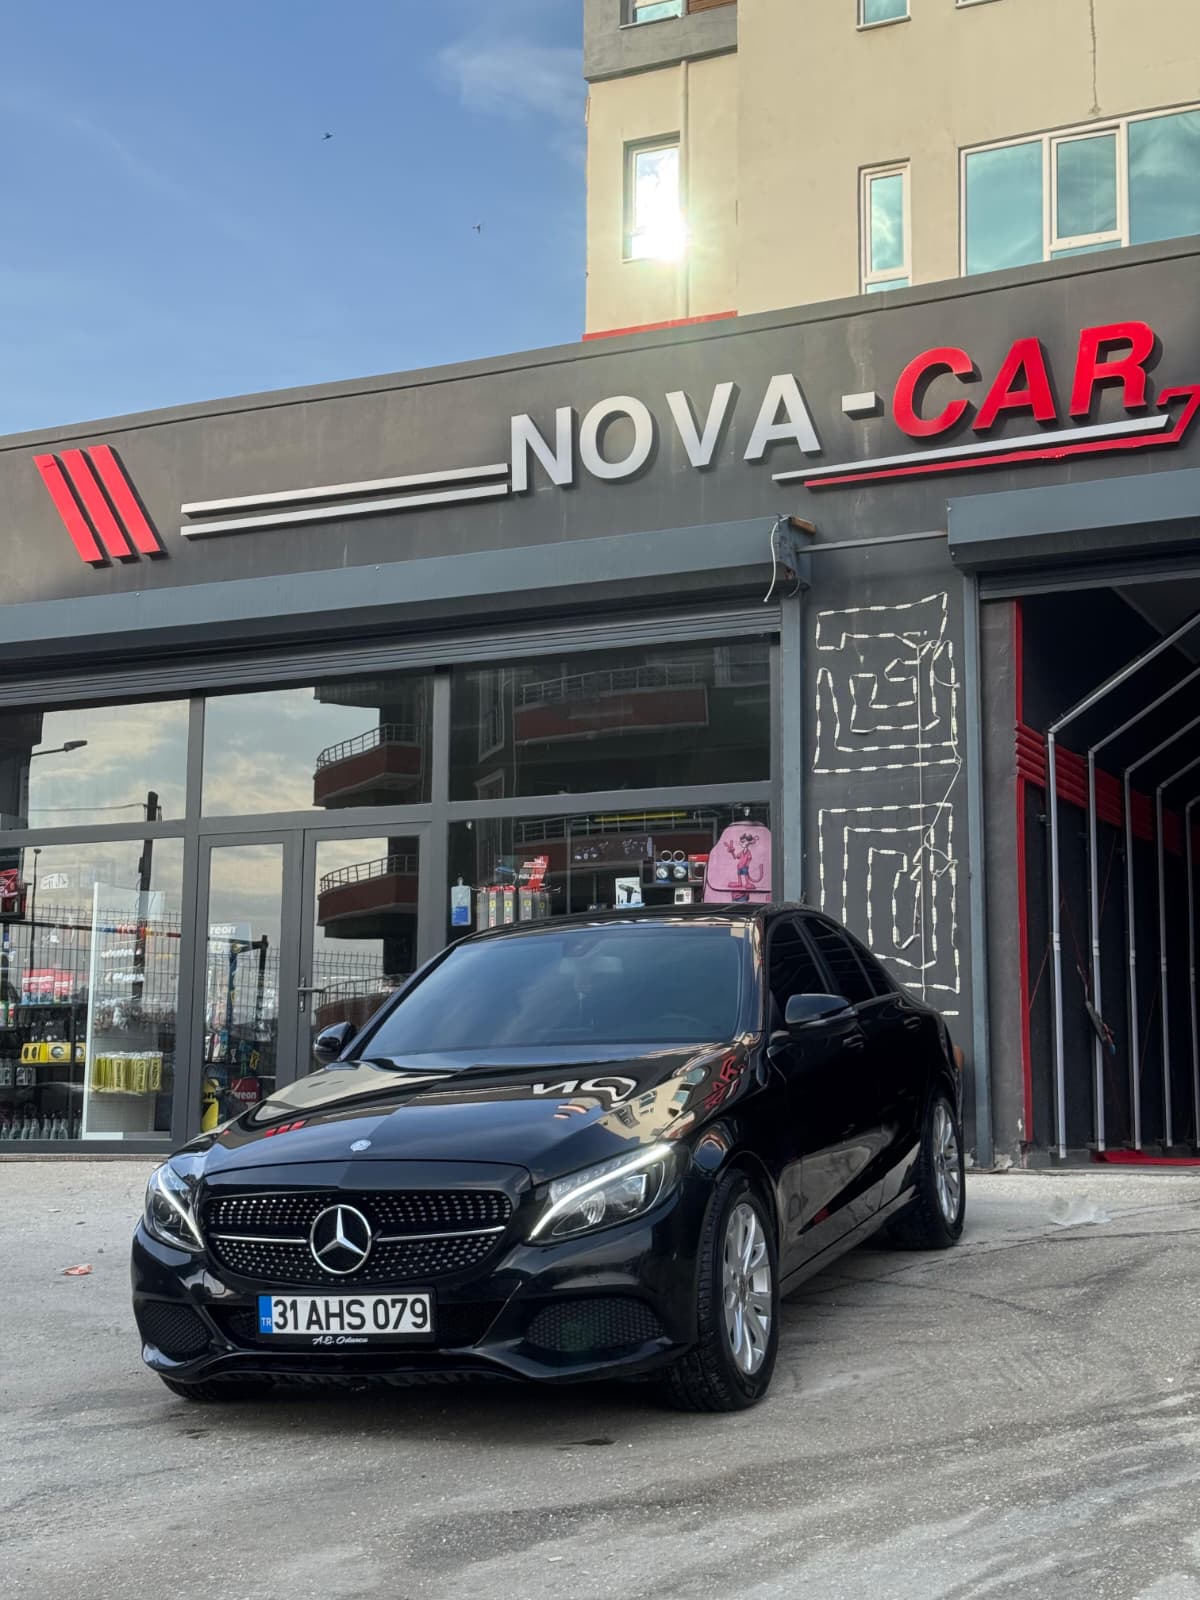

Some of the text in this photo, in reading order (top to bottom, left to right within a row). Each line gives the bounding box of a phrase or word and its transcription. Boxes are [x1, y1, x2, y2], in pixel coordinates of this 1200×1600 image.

[511, 373, 821, 492] NOVA
[893, 321, 1154, 438] CAR
[261, 1317, 272, 1327] TR
[273, 1297, 428, 1331] 31 AHS 079
